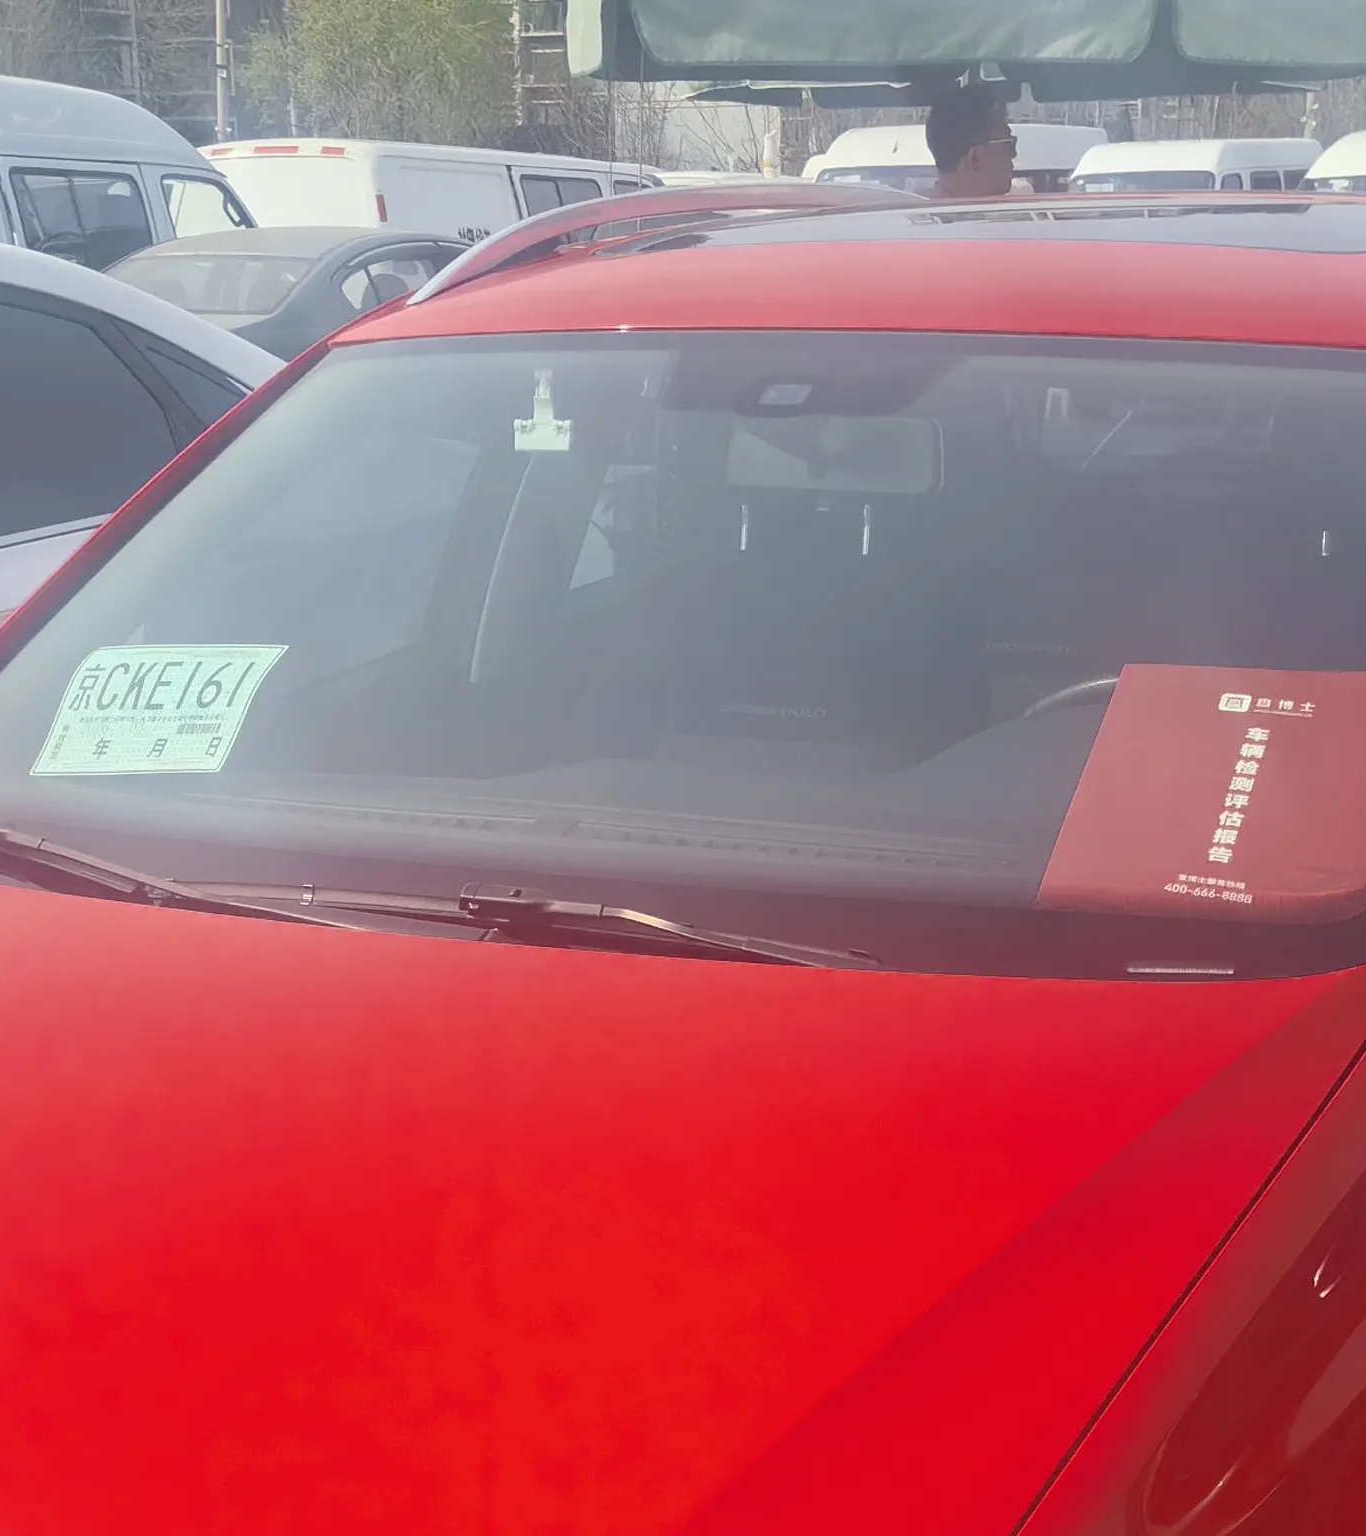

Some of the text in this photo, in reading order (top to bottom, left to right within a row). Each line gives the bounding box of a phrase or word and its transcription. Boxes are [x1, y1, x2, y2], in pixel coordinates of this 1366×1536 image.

[68, 661, 257, 711] 京CKE161
[91, 738, 113, 759] 年
[146, 738, 168, 758] 月
[204, 736, 223, 757] 日
[1208, 727, 1271, 864] 车辆检测评估报告
[1163, 883, 1253, 904] 400-666-8888
